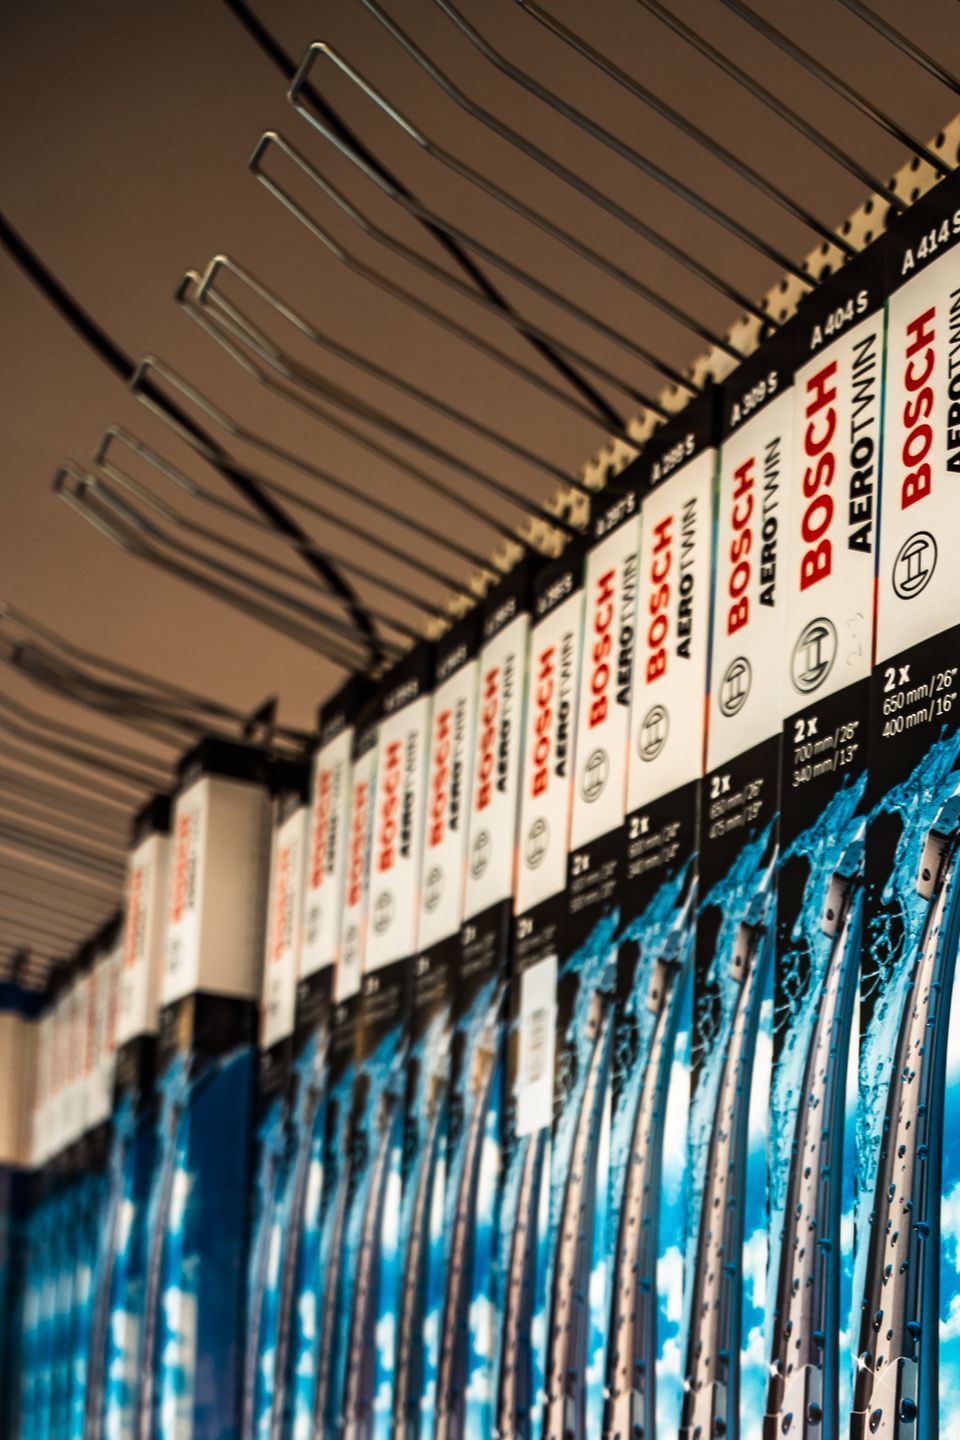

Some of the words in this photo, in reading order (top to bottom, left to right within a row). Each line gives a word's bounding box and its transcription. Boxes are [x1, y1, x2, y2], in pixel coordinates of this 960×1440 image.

[856, 290, 869, 314] S
[901, 249, 915, 275] A
[917, 224, 950, 260] 414
[800, 360, 838, 592] BOSCH
[848, 333, 877, 554] AEROTWIN
[901, 306, 936, 511] BOSCH
[646, 514, 675, 685] BOSCH
[676, 497, 698, 660] AEROTWIN
[727, 456, 756, 637] BOSCH
[759, 436, 782, 608] AEROTWIN
[588, 569, 617, 730] BOSCH
[616, 553, 638, 706] AEROTWIN
[883, 692, 905, 715] 650
[532, 645, 556, 798] BOSCH
[882, 715, 904, 738] 400
